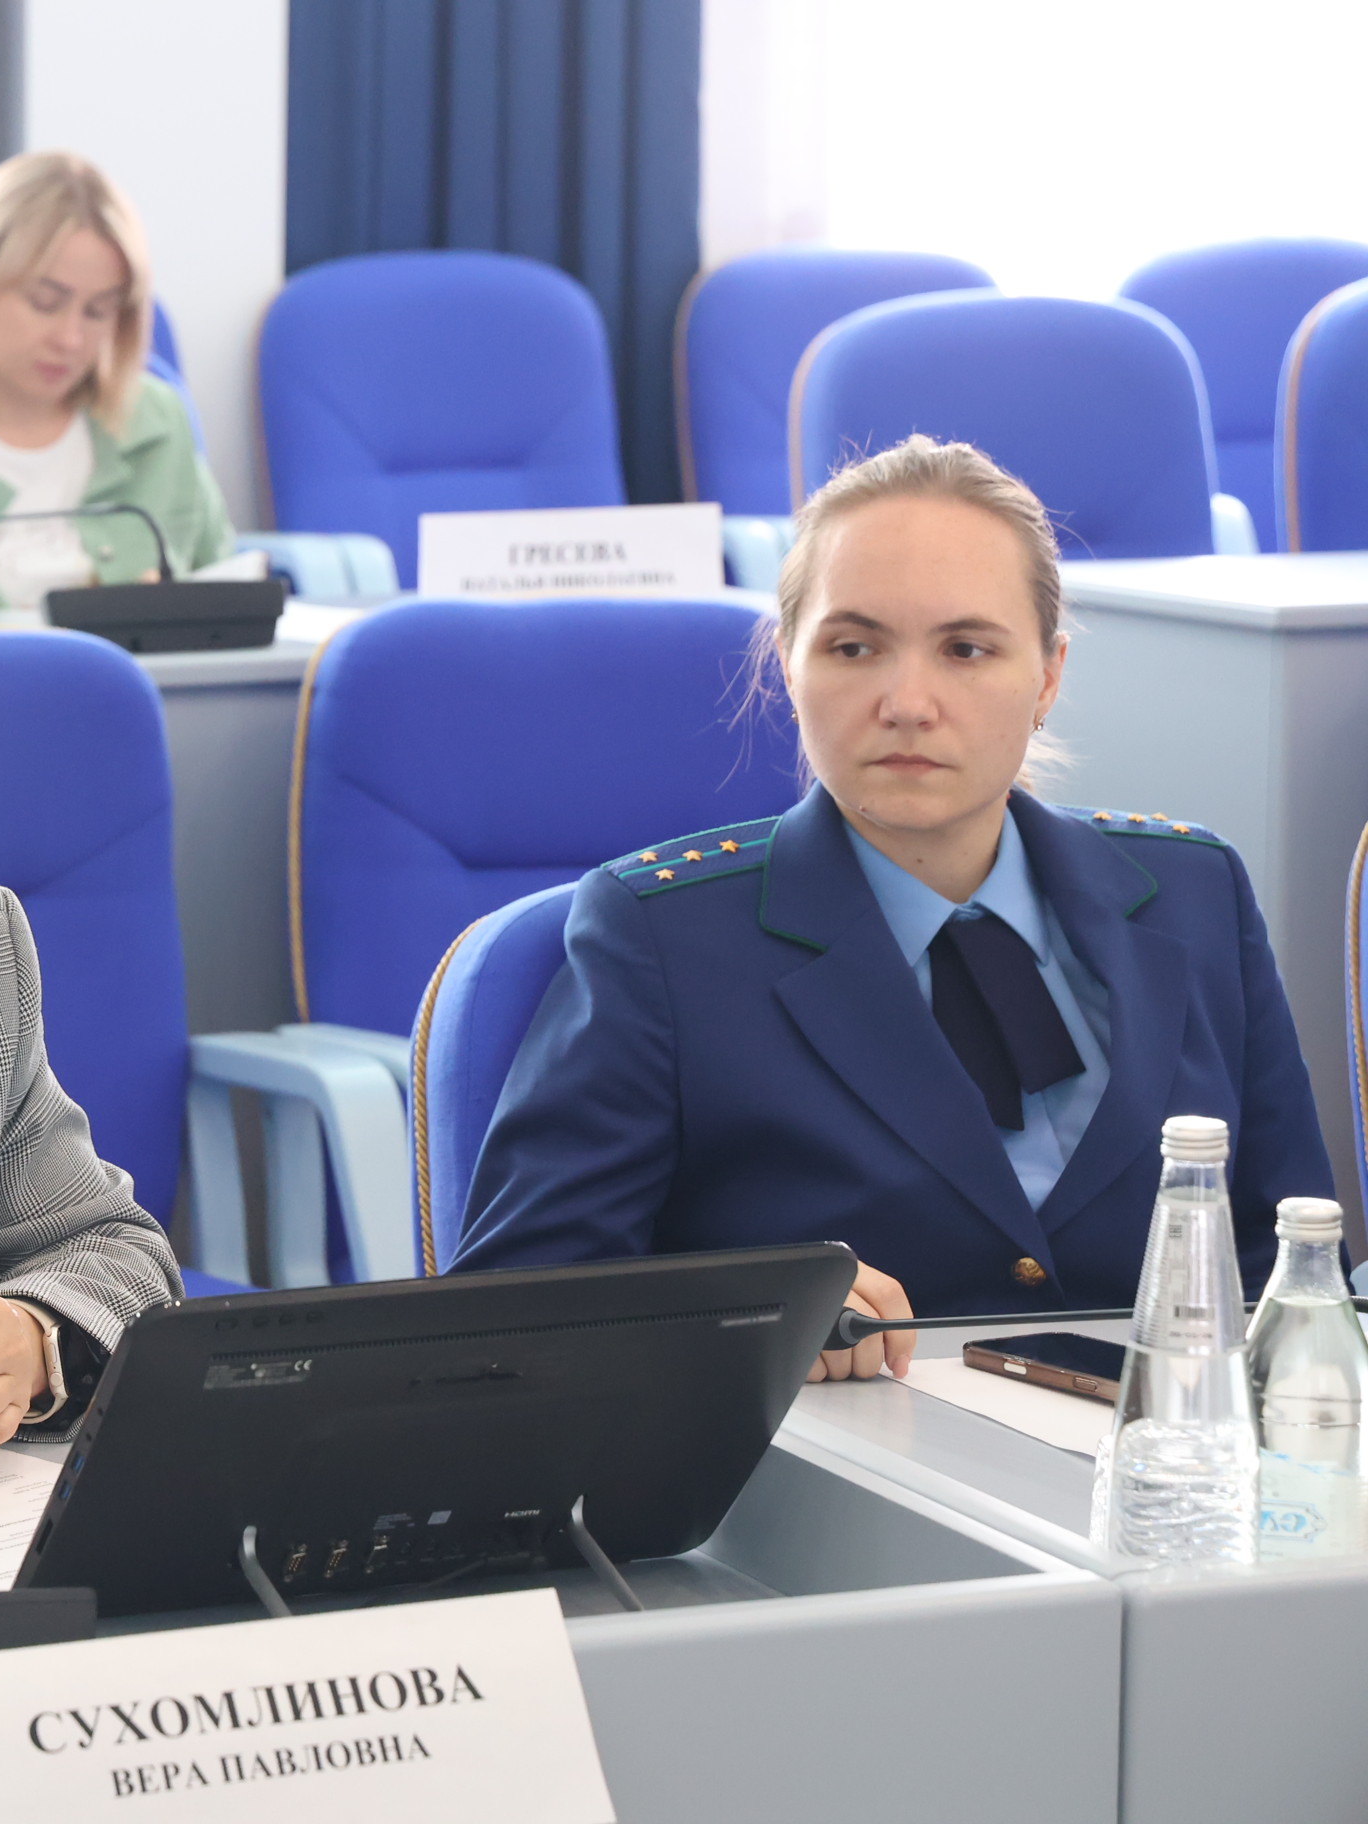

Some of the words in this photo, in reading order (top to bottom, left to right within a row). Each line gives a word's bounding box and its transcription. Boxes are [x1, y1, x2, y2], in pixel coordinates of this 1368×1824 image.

[28, 1664, 484, 1754] СУХОМЛИНОВА
[112, 1758, 209, 1798] ВЕРА
[220, 1734, 431, 1783] ПАВЛОВНА
